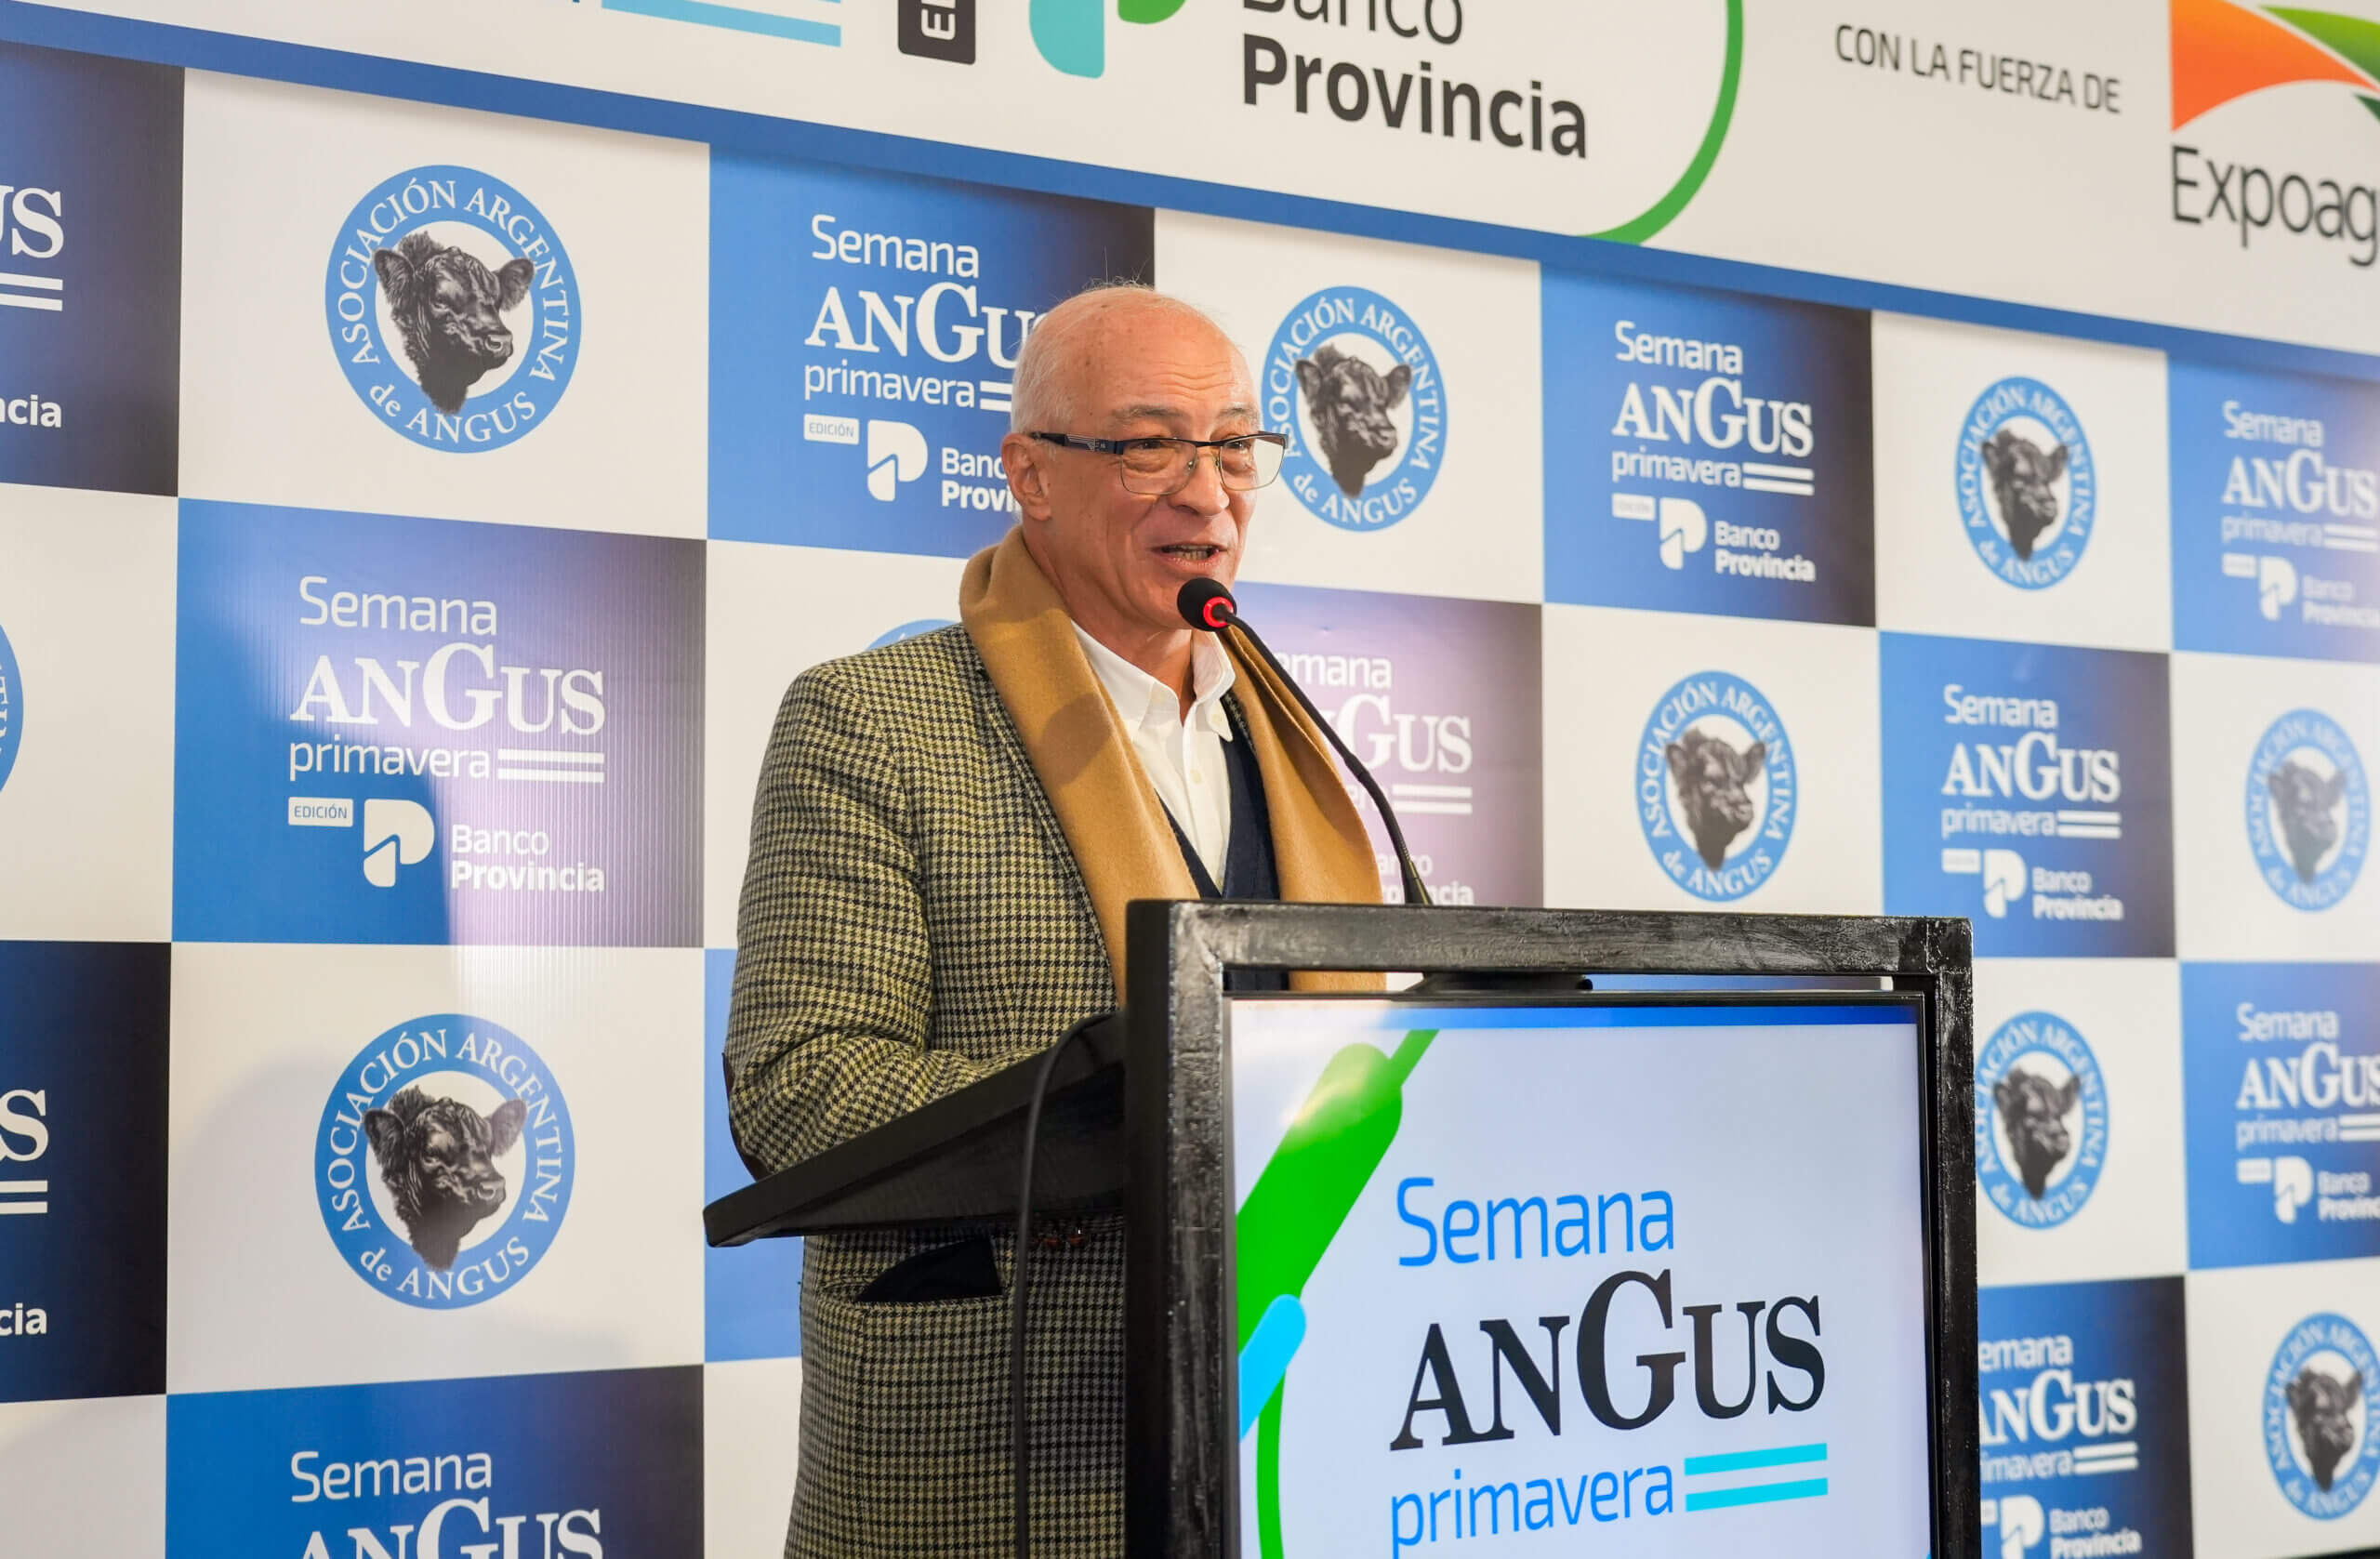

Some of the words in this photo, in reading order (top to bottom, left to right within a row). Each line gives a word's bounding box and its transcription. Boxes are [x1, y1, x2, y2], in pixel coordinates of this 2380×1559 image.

[1242, 0, 1463, 45] nco
[1835, 24, 1900, 72] CON
[1911, 38, 1950, 81] LA
[1959, 49, 2075, 105] FUERZA
[2084, 73, 2122, 114] DE
[1243, 33, 1586, 159] Provincia
[2171, 144, 2379, 267] Expoag
[812, 214, 979, 278] Semana
[337, 178, 456, 365] ASOCIACIÓN
[463, 187, 570, 382] ARGENTINA
[804, 282, 1050, 369] ANGU
[1615, 320, 1743, 375] Semana
[805, 359, 974, 408] primavera
[1360, 304, 1440, 469] ARGENTINA
[369, 383, 402, 417] de
[405, 391, 536, 444] ANGUS
[809, 422, 855, 438] EDICIÓN
[1611, 377, 1814, 457] ANGUS
[2222, 400, 2324, 447] Semana
[942, 447, 1008, 480] Banc
[1612, 445, 1741, 487] primavera
[2221, 448, 2378, 519] ANGUS
[942, 480, 1022, 512] Provi
[1293, 473, 1318, 503] de
[1321, 478, 1418, 524] ANGUS
[1714, 521, 1780, 551] Banco
[1714, 548, 1816, 582] Provincia
[298, 575, 497, 636] Semana
[289, 642, 605, 735] ANGUS
[1274, 652, 1392, 689] mana
[1944, 683, 2058, 729] Semana
[289, 733, 490, 782] primavera
[1324, 694, 1473, 773] GUS
[1941, 731, 2121, 803] ANGUS
[294, 803, 348, 819] EDICIÓN
[1941, 801, 2056, 839] primavera
[451, 825, 549, 856] Banco
[451, 860, 605, 892] Provincia
[1687, 848, 1773, 895] ANGUS
[2237, 1002, 2340, 1041] Semana
[328, 1029, 448, 1232] ASOCIACIÓN
[456, 1032, 562, 1223] ARGENTINA
[1396, 1175, 1673, 1267] Semana
[360, 1247, 392, 1281] de
[397, 1236, 529, 1300] ANGUS
[1389, 1268, 1827, 1452] ANGUS
[1978, 1334, 2073, 1372] emana
[291, 1451, 492, 1502] Semana
[1980, 1450, 2072, 1483] imavera
[1392, 1465, 1673, 1559] primavera
